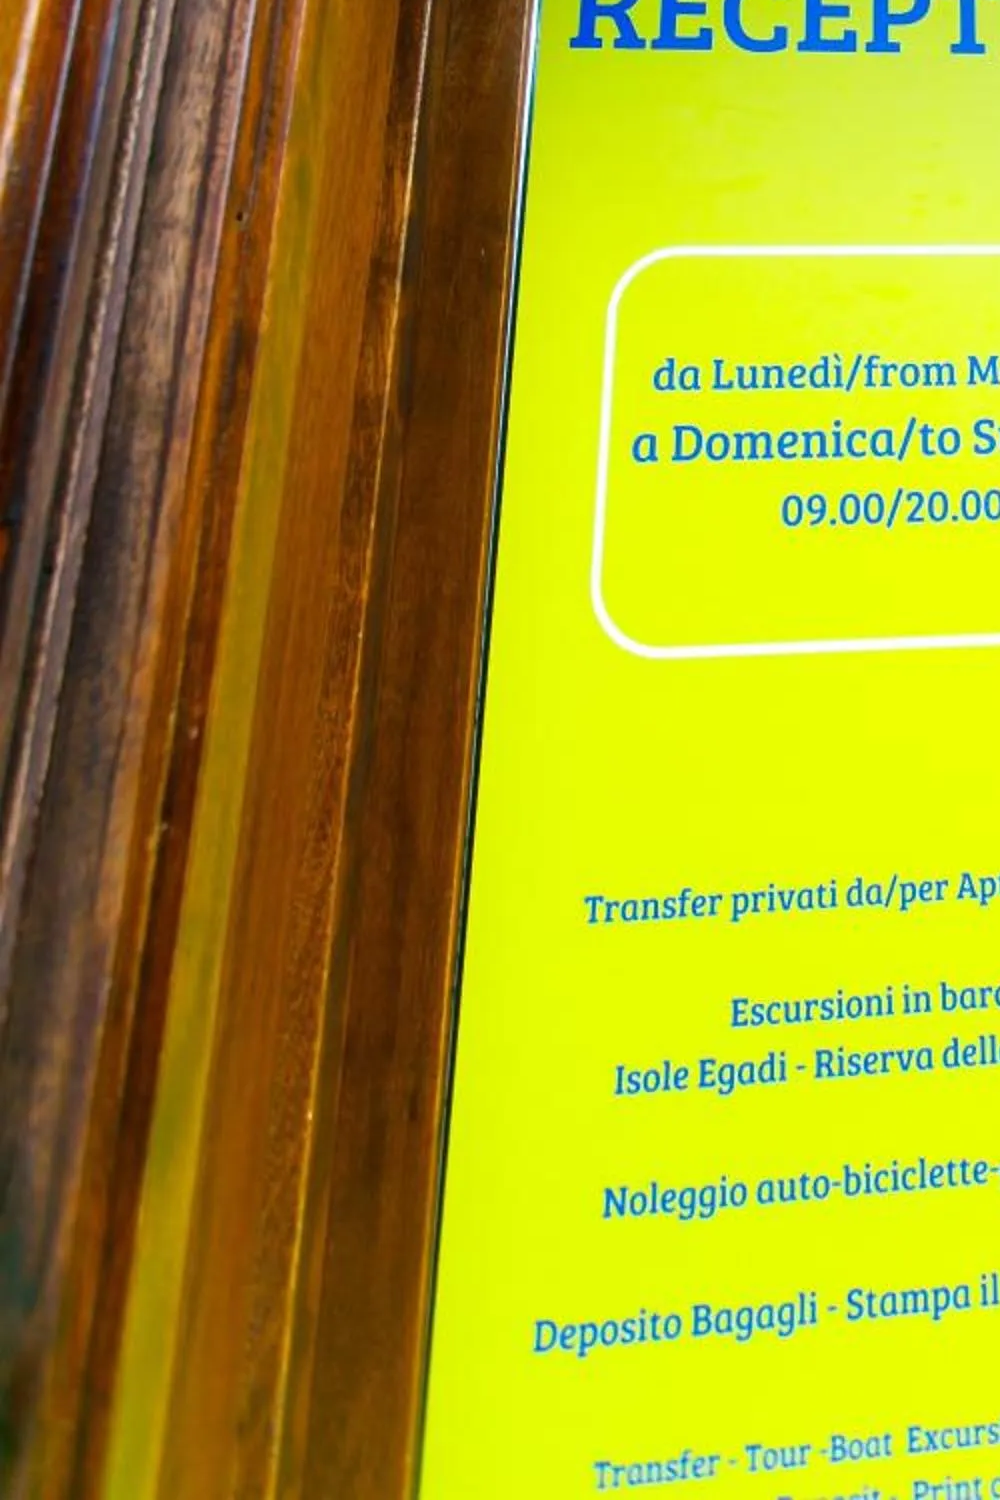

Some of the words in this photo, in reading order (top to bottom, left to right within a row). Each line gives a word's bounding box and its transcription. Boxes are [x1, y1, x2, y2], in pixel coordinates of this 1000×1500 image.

[652, 357, 701, 392] da
[711, 353, 958, 392] Lunedì/from
[631, 433, 659, 464] a
[671, 417, 961, 463] Domenica/to
[583, 887, 724, 925] Transfer
[730, 879, 838, 924] privati
[845, 874, 949, 912] da/per
[730, 986, 895, 1028] Escursioni
[903, 984, 932, 1015] in
[614, 1059, 689, 1096] Isole
[698, 1051, 787, 1096] Egadi
[814, 1046, 934, 1079] Riserva
[602, 1175, 748, 1221] Noleggio
[533, 1309, 683, 1359] Deposito
[691, 1291, 818, 1342] Bagagli
[846, 1284, 972, 1322] Stampa
[980, 1272, 1000, 1307] il
[593, 1449, 721, 1489] Transfer
[744, 1444, 811, 1472] Tour
[913, 1478, 982, 1500] Print
